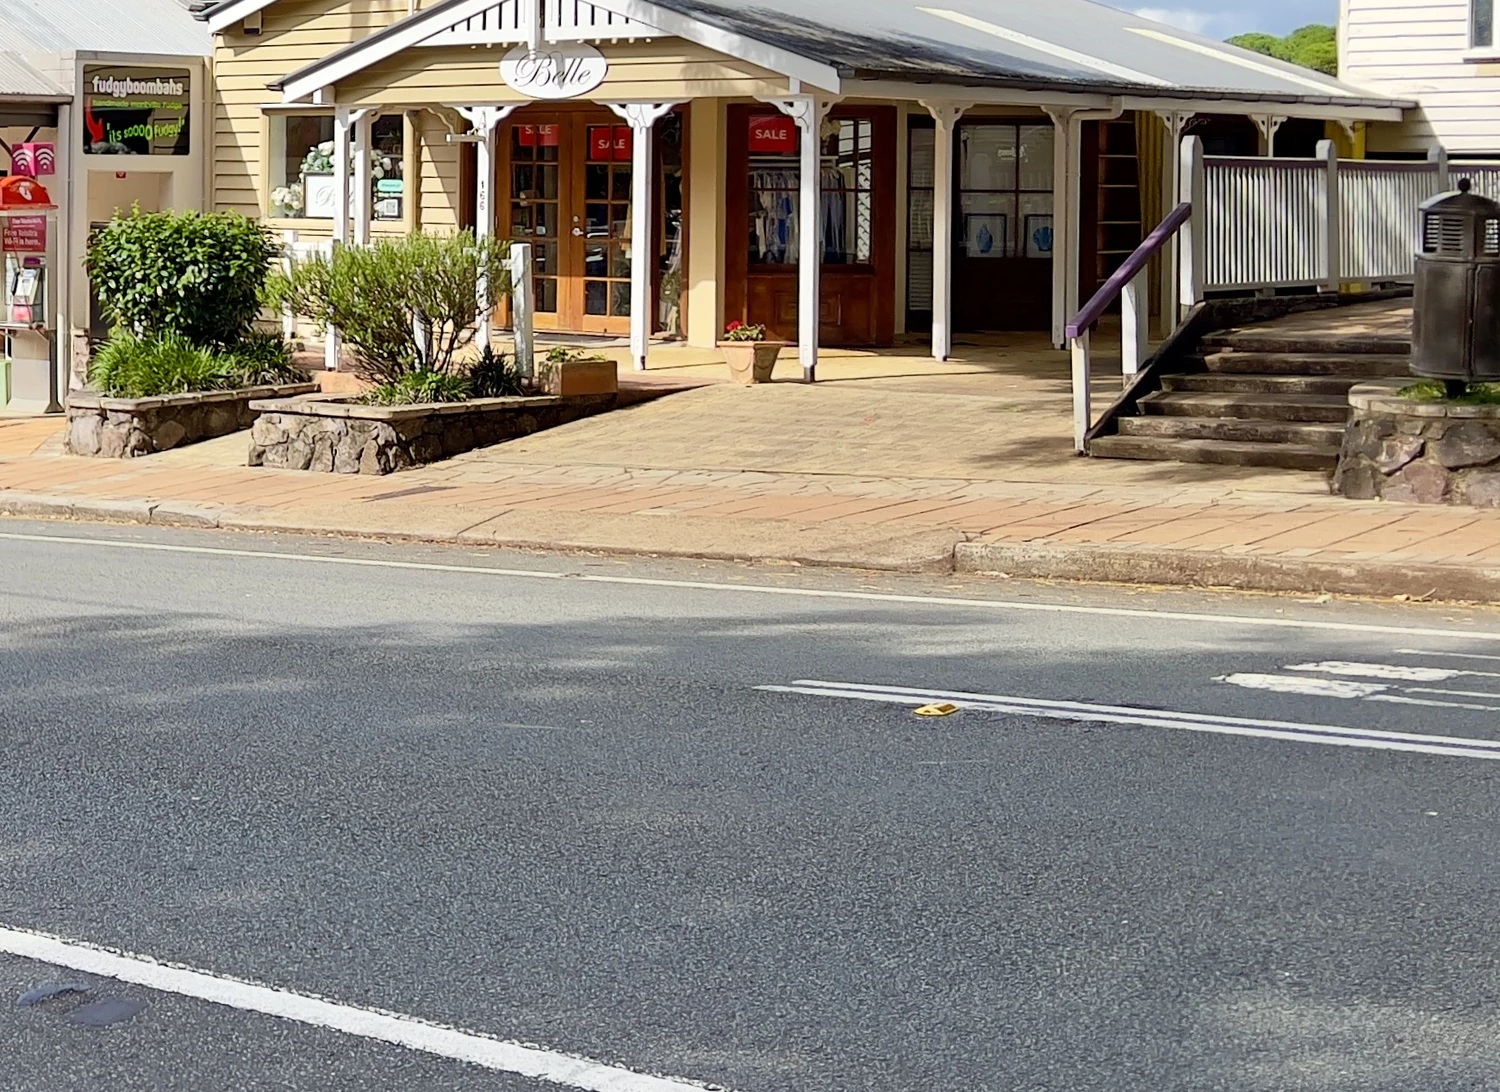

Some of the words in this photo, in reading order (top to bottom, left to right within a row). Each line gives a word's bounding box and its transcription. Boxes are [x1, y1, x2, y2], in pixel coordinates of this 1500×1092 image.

[513, 50, 592, 87] Belle
[92, 75, 183, 98] fudgyboombahs
[755, 129, 787, 140] SALE
[4, 228, 17, 238] Free
